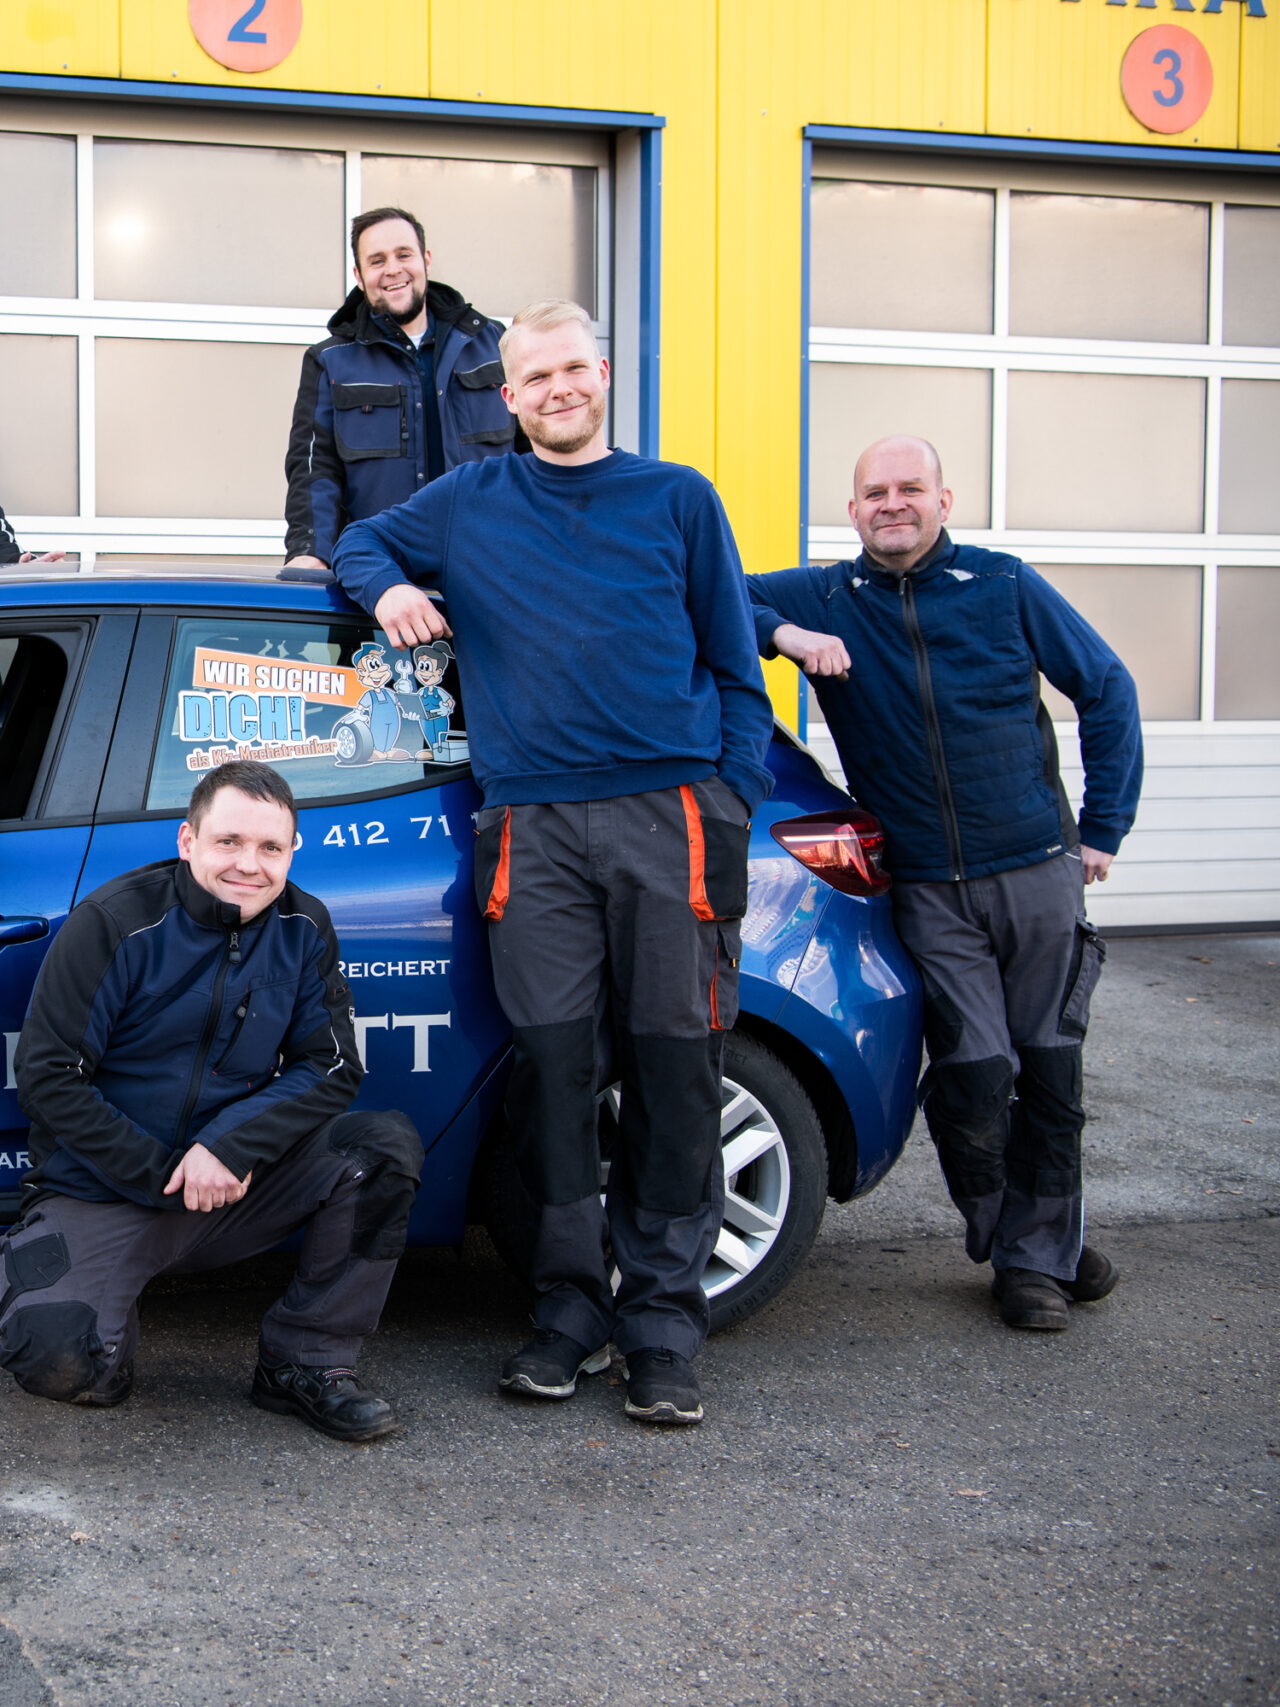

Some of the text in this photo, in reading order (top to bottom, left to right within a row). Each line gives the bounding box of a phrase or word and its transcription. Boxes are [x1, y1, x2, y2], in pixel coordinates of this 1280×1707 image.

[227, 0, 267, 44] 2
[1152, 48, 1184, 107] 3
[203, 659, 346, 696] WIR SUCHEN
[183, 694, 303, 741] DICH!
[190, 752, 210, 769] als
[323, 821, 389, 848] 412
